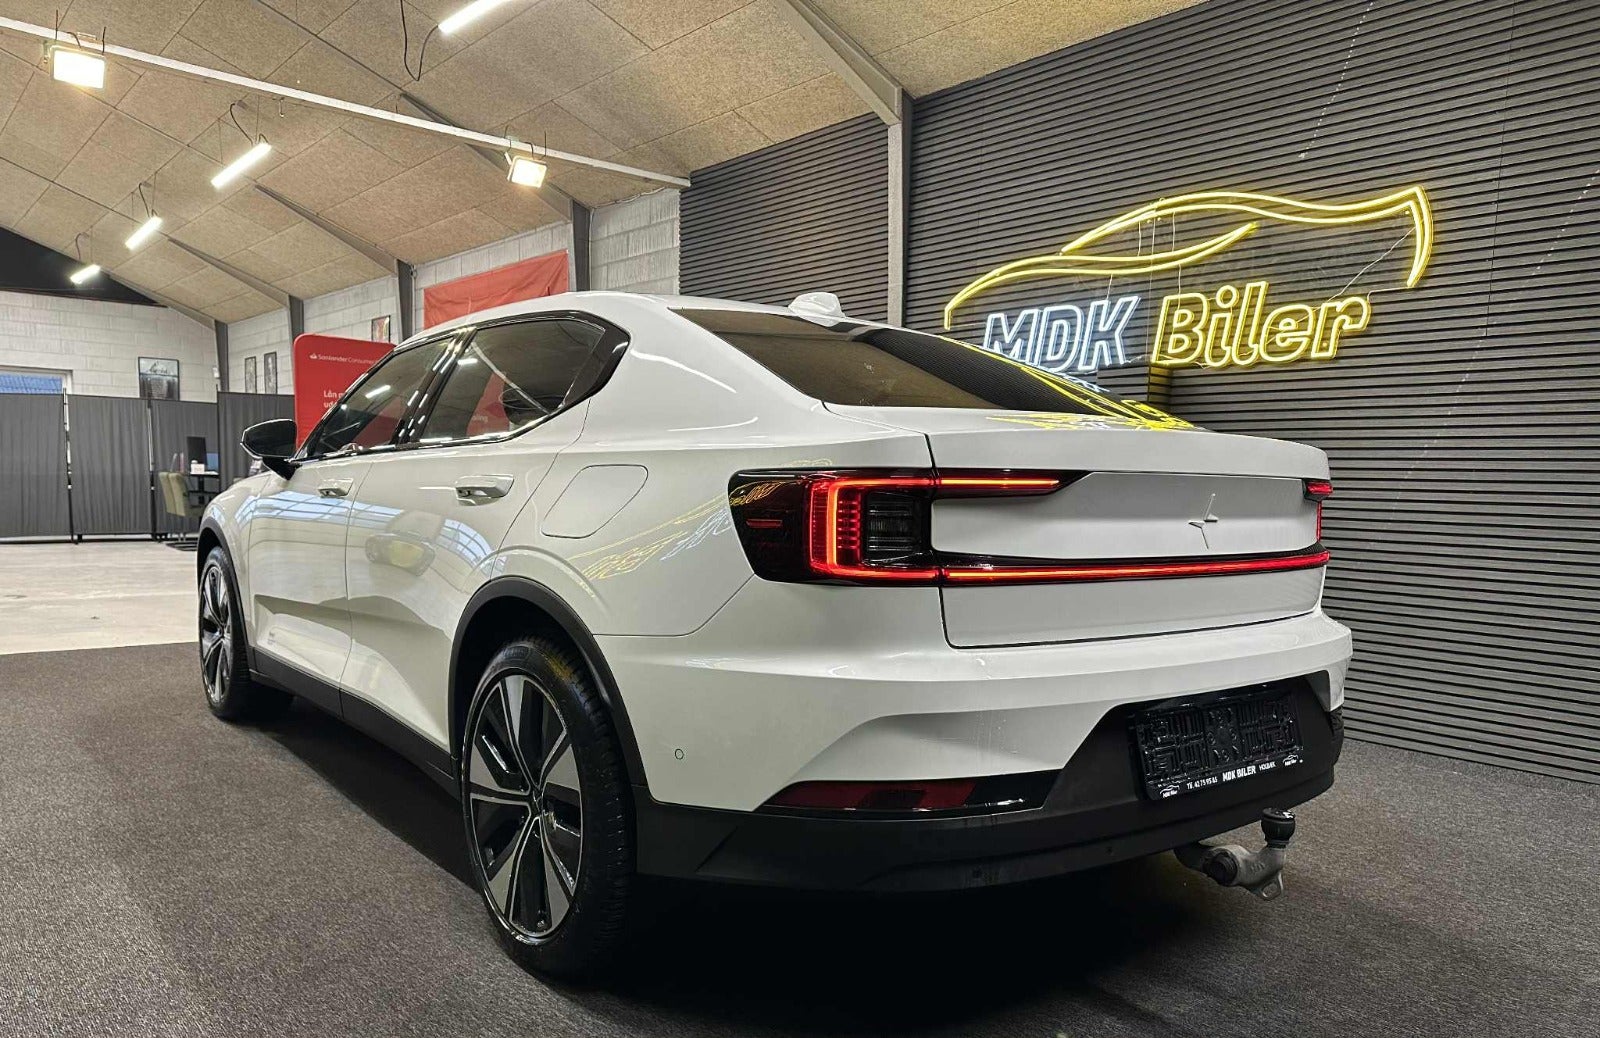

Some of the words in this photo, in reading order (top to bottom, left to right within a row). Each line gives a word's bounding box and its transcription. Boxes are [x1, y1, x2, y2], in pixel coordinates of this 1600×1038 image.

[983, 295, 1141, 371] MDK
[1150, 281, 1371, 369] Biler
[318, 354, 347, 362] Santander
[323, 390, 338, 398] Lån
[1222, 770, 1236, 782] MDK
[1236, 765, 1256, 778] BILER
